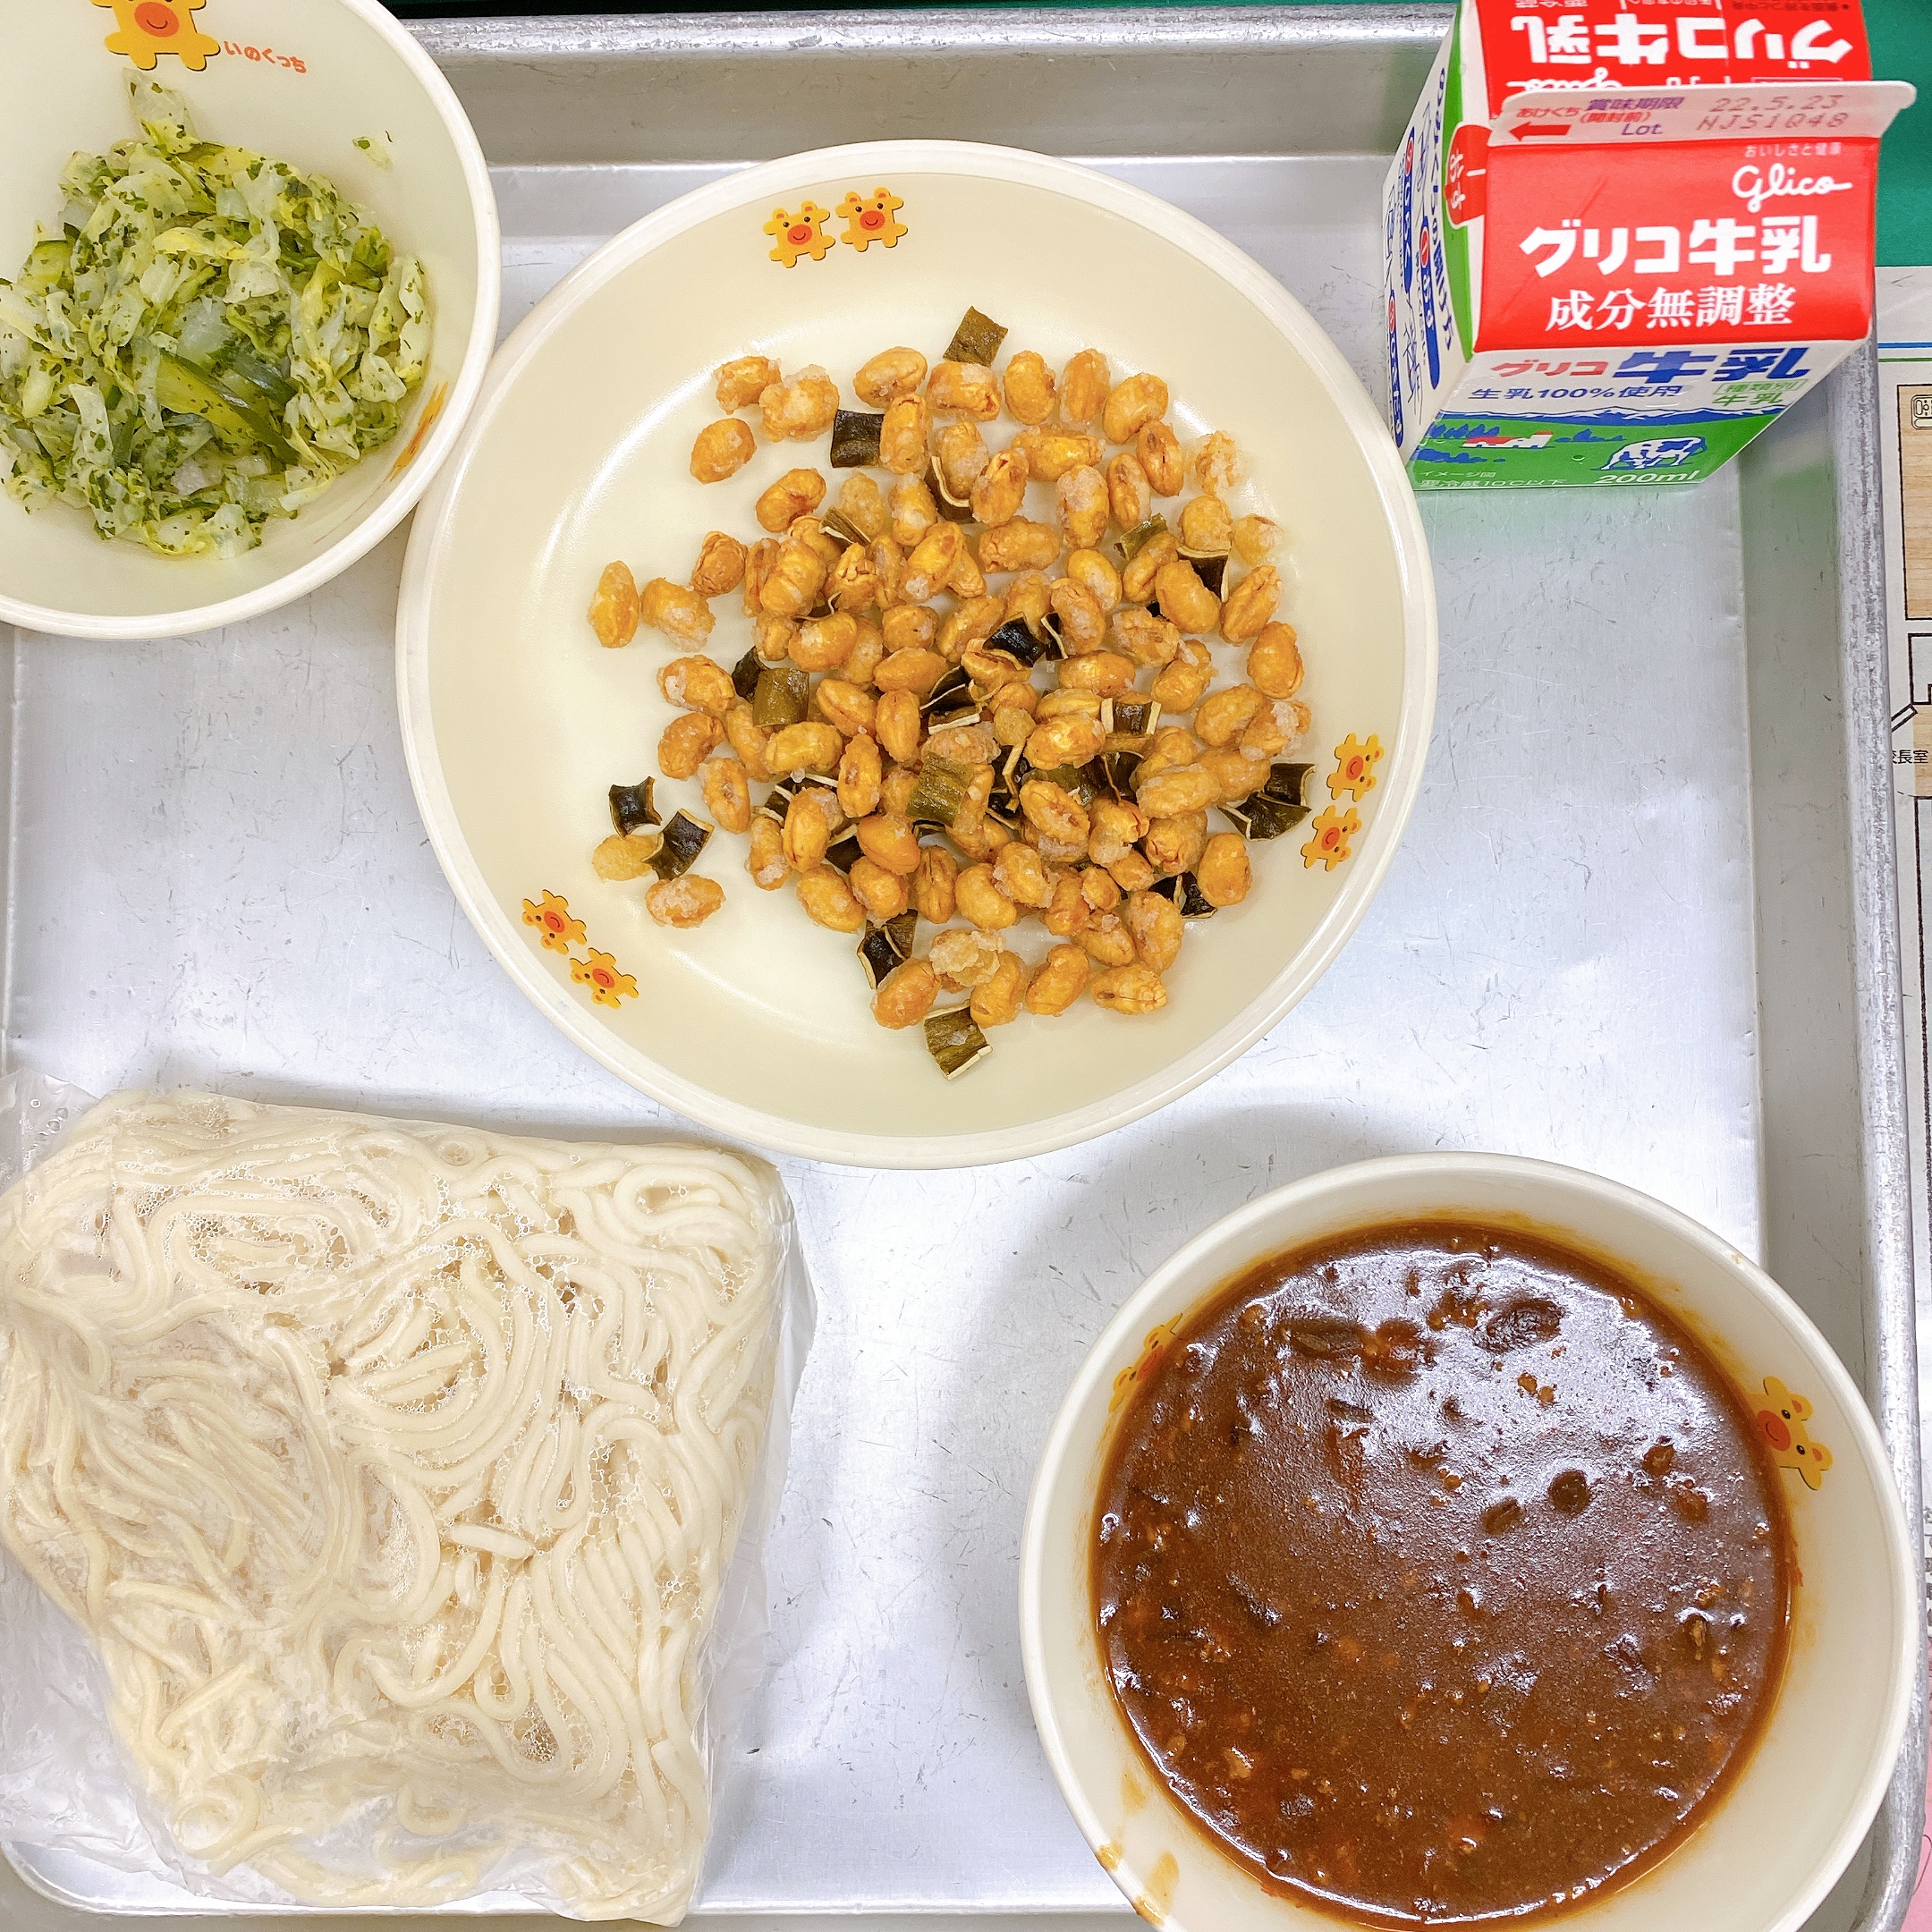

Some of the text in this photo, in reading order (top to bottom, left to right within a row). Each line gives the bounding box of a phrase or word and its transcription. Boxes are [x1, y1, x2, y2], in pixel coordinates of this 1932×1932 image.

[223, 40, 307, 73] いのくっち
[1510, 13, 1853, 69] グリコ牛乳
[1584, 94, 1844, 113] 賞味期限 22.5.23
[1449, 148, 1467, 211] おす
[1732, 162, 1853, 213] Glico
[1519, 215, 1832, 278] グリコ牛乳
[1545, 282, 1797, 332] 成分無調整
[1490, 346, 1811, 384] グリコ 牛乳
[1468, 385, 1684, 401] 生乳100%使用
[1712, 392, 1786, 407] 牛乳
[1594, 470, 1701, 486] 200ml
